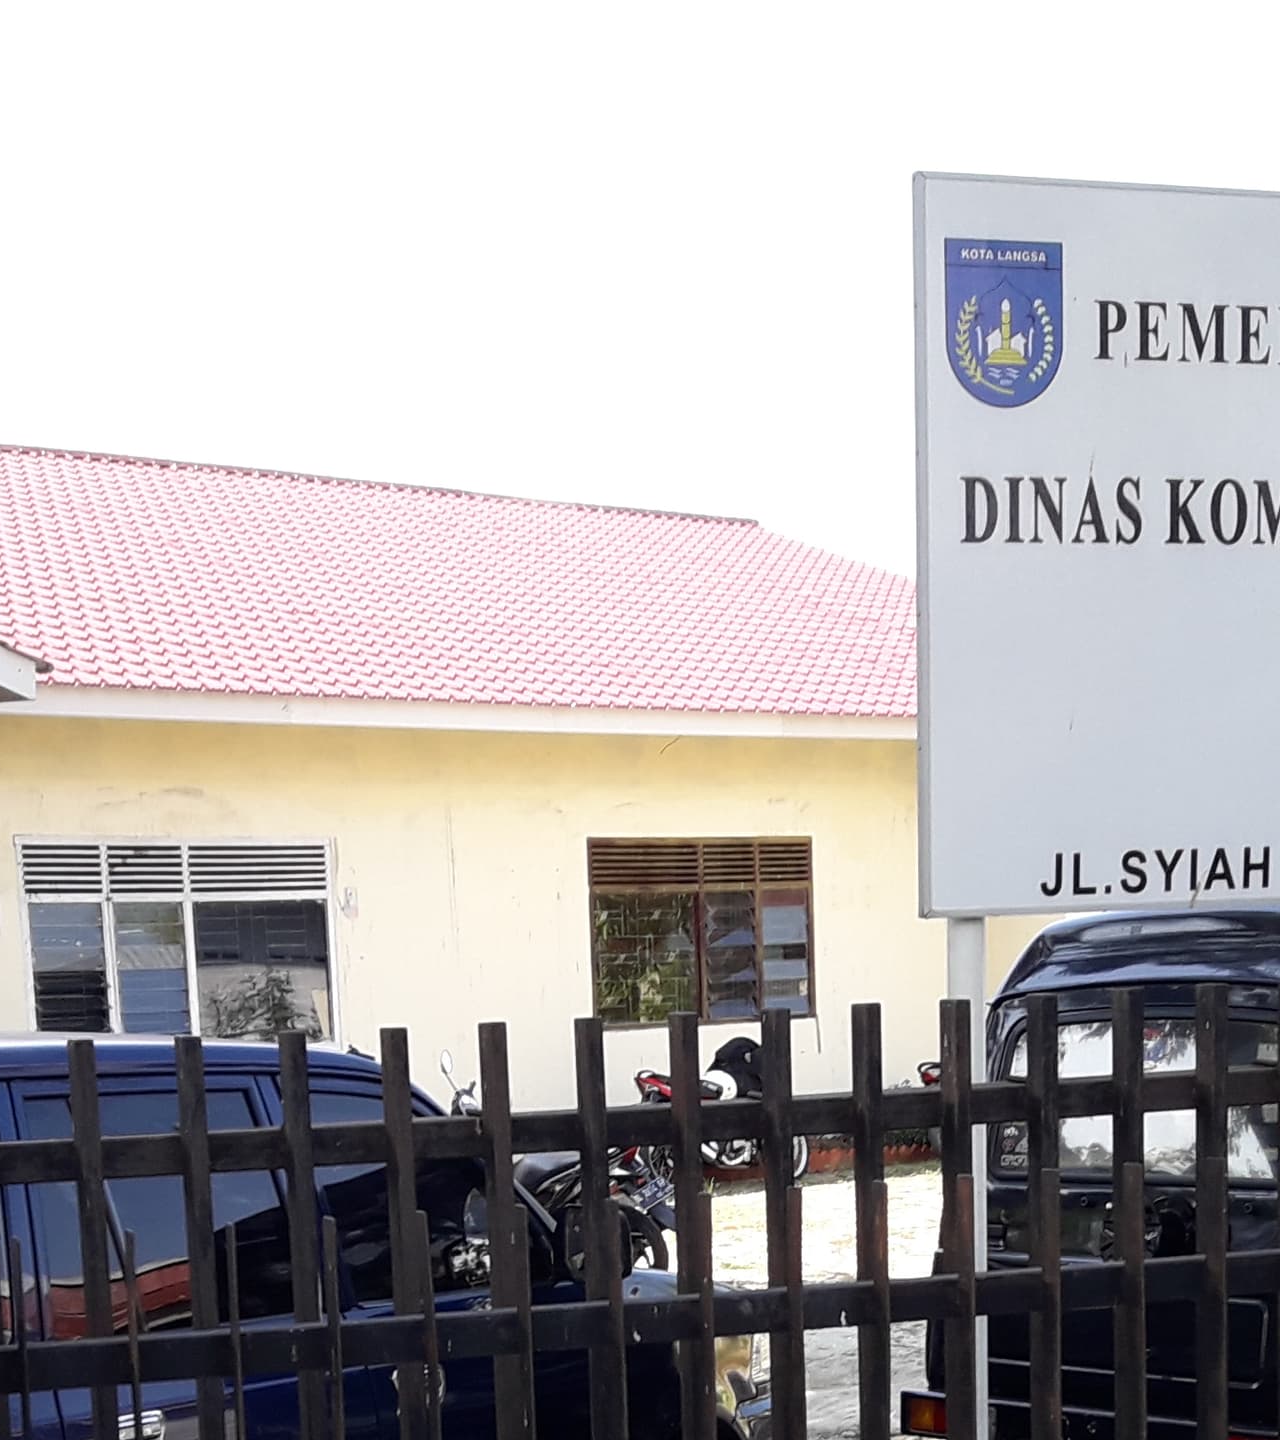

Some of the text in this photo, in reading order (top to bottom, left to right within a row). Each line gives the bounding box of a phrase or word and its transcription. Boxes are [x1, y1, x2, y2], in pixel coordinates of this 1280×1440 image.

[960, 247, 1047, 263] KOTA LANGSA
[960, 476, 1143, 546] DINAS
